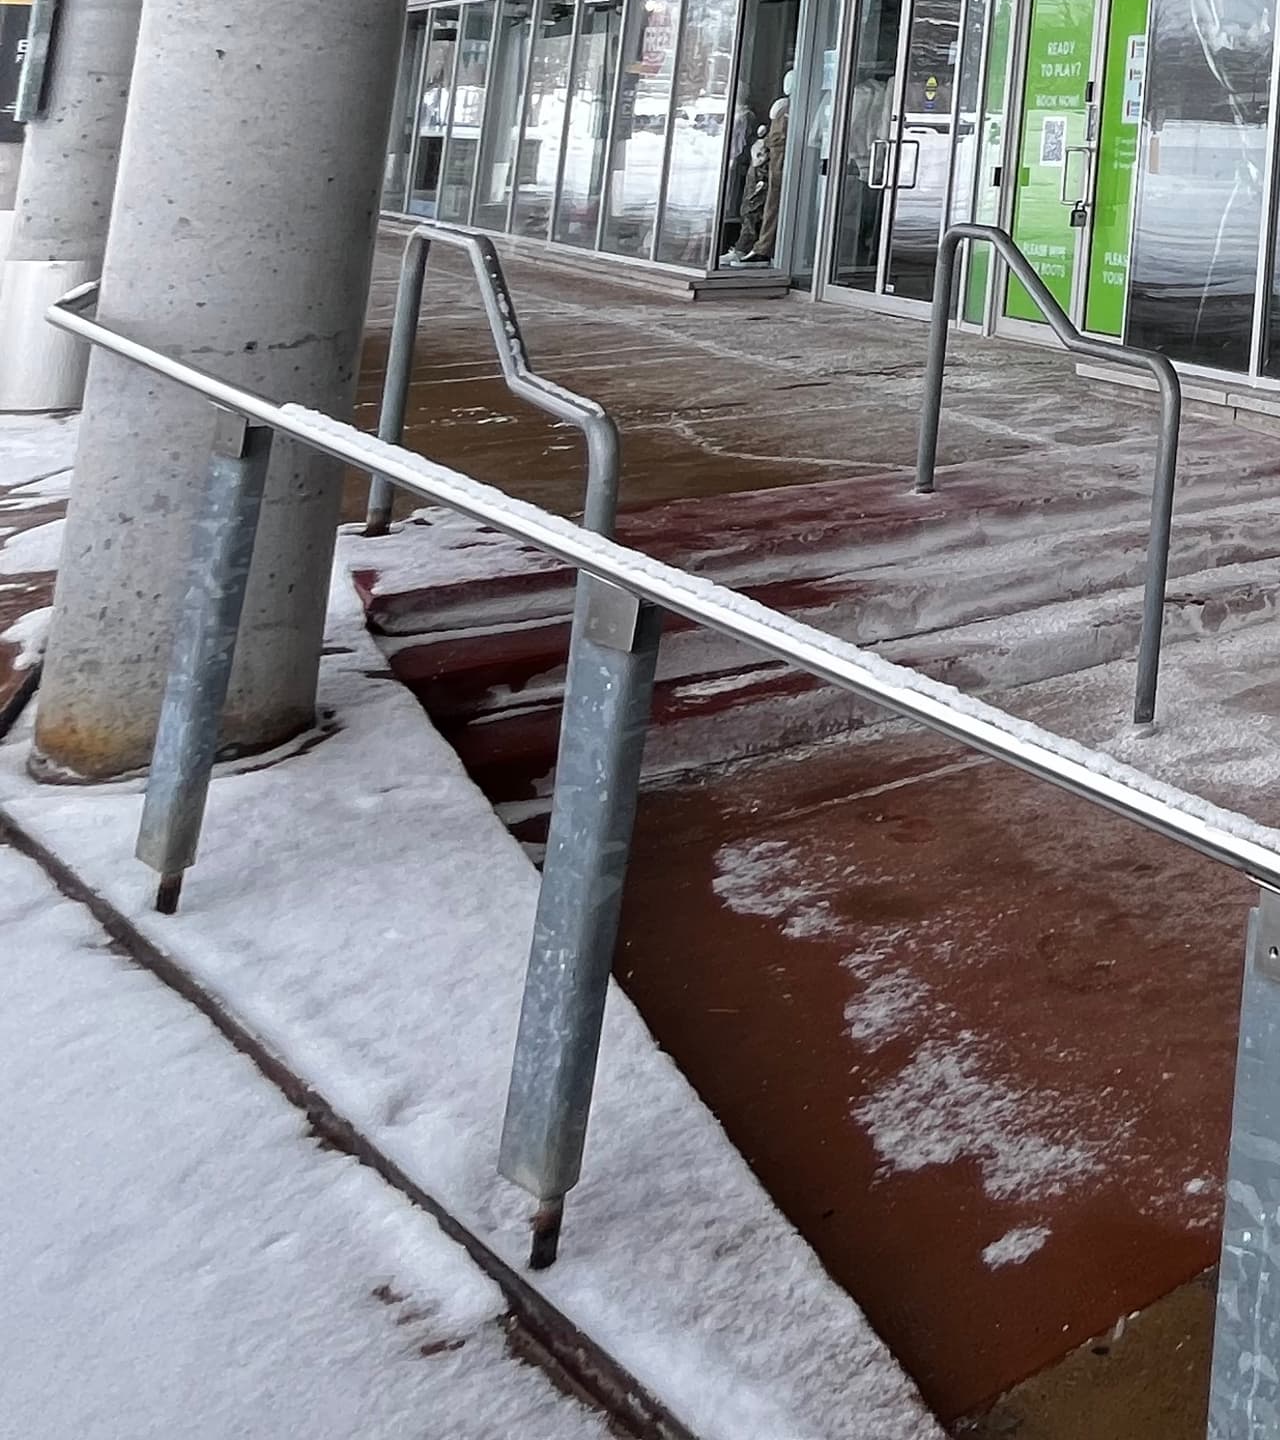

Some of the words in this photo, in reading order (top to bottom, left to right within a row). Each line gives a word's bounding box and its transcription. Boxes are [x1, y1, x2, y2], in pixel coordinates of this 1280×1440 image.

[1047, 40, 1076, 56] READY
[1041, 63, 1053, 77] TO
[1054, 61, 1082, 77] PLAY?
